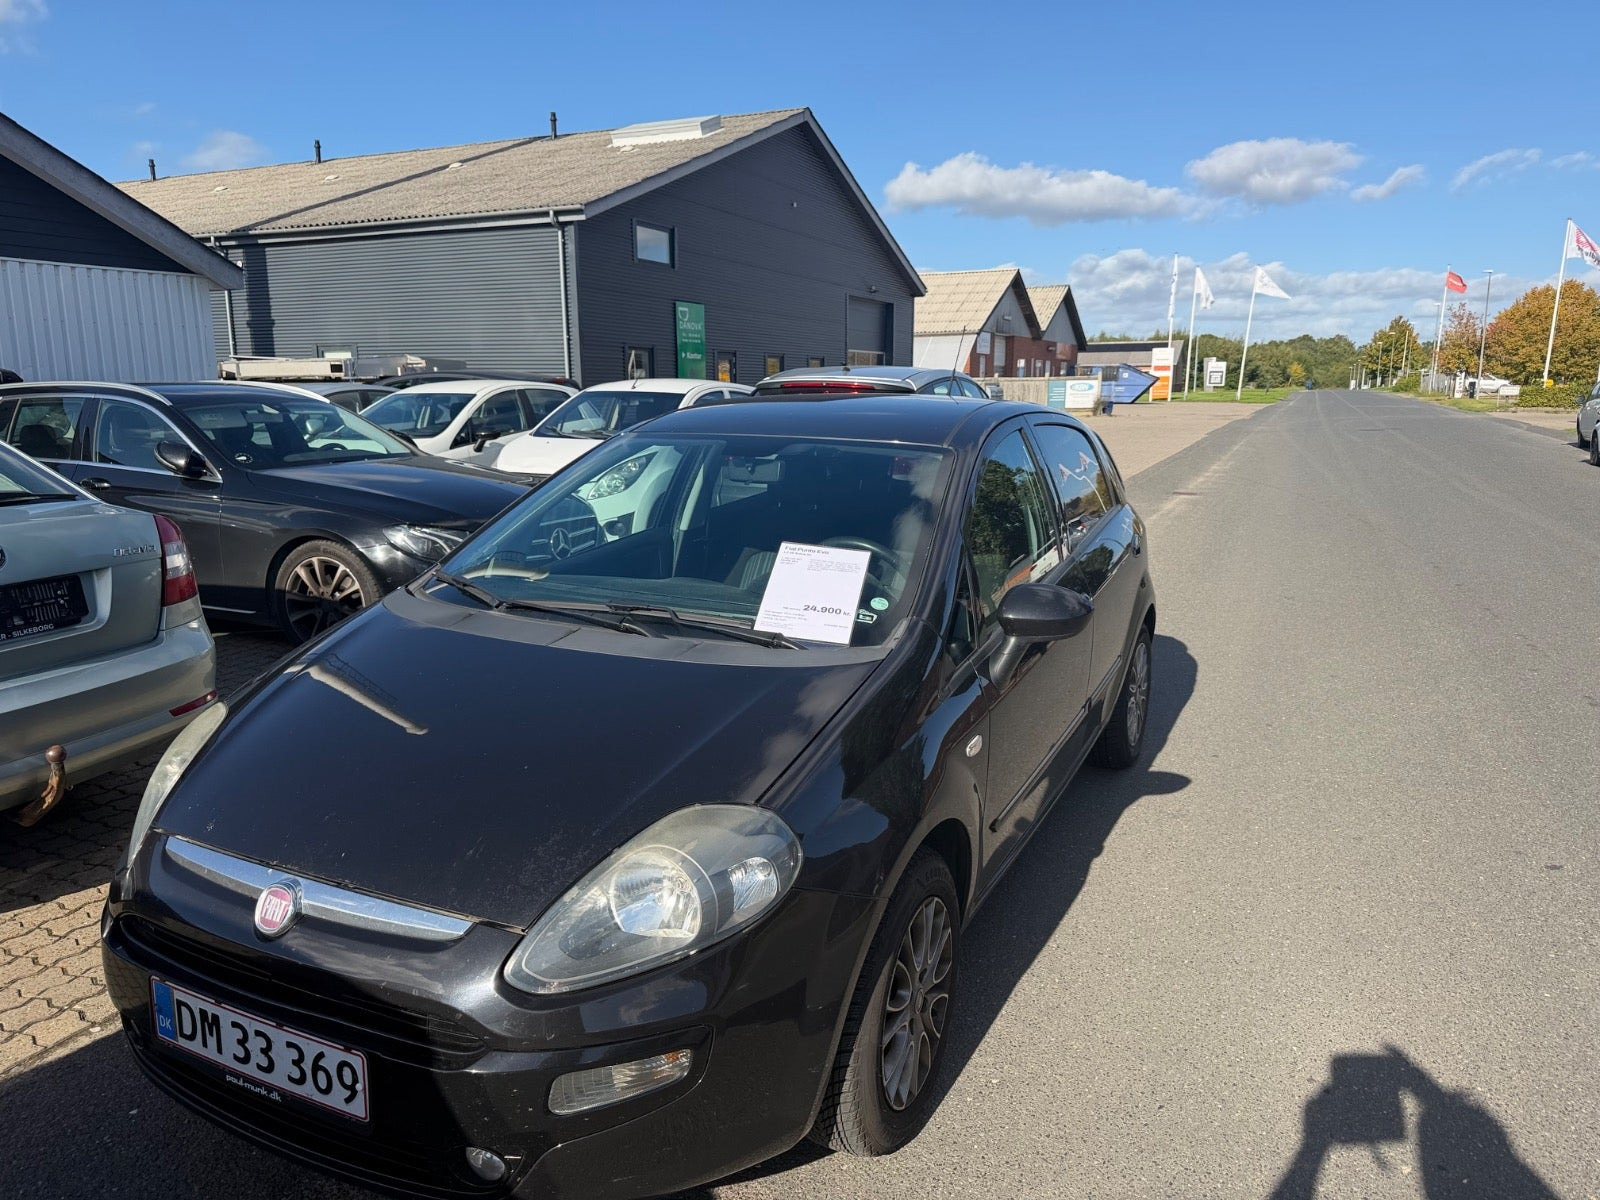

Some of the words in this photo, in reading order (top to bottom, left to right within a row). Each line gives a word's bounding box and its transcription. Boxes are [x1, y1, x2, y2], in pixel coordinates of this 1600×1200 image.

[686, 352, 702, 360] Kontor
[802, 604, 842, 615] 24.900
[11, 623, 55, 638] SILKEBORG
[262, 894, 289, 922] FIAT
[158, 1014, 173, 1032] DK
[176, 998, 223, 1056] DM
[230, 1020, 276, 1075] 33
[285, 1041, 360, 1105] 369
